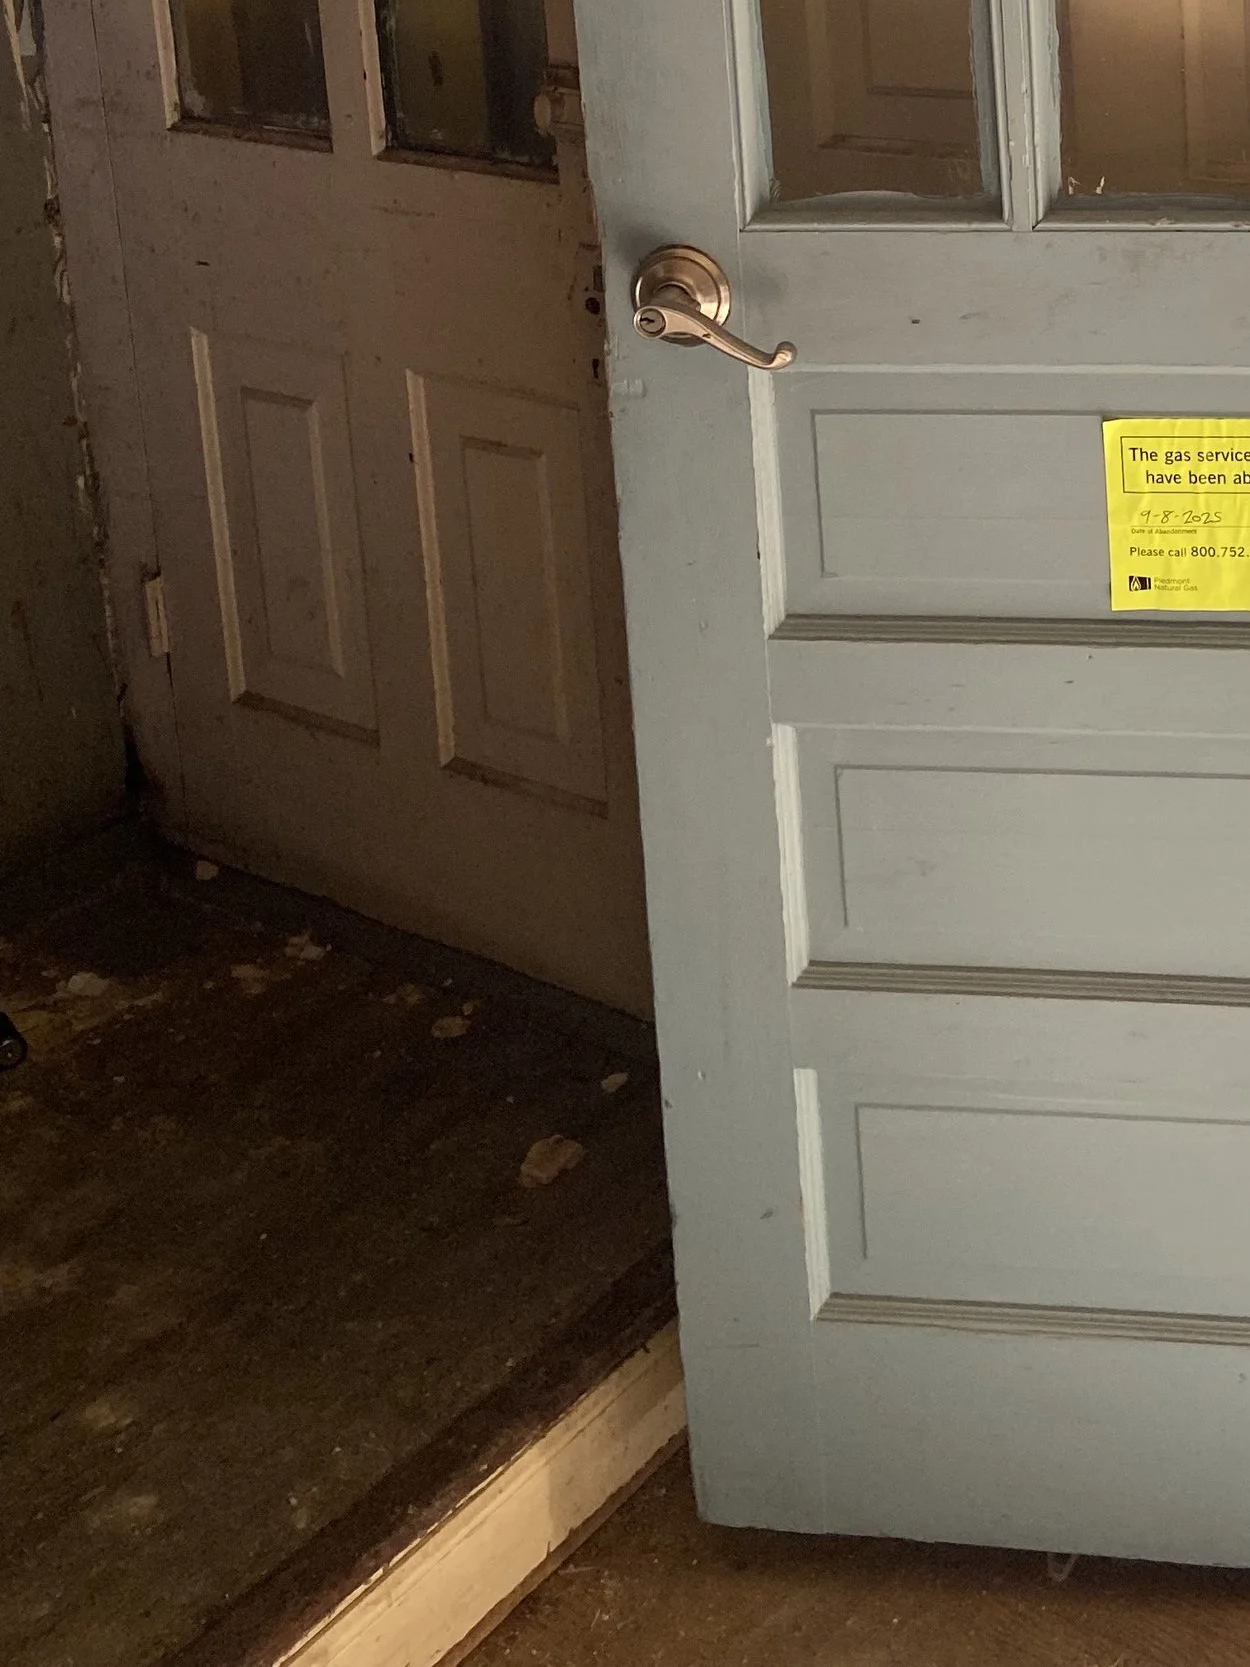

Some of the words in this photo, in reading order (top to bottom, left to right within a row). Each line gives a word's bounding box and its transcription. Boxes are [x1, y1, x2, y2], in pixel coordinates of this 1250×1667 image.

[1129, 448, 1159, 462] The
[1164, 449, 1191, 465] gas
[1145, 470, 1182, 484] have
[1189, 472, 1227, 485] been
[1140, 510, 1222, 525] 9-8-2025
[1129, 547, 1165, 558] Please
[1168, 547, 1187, 557] call
